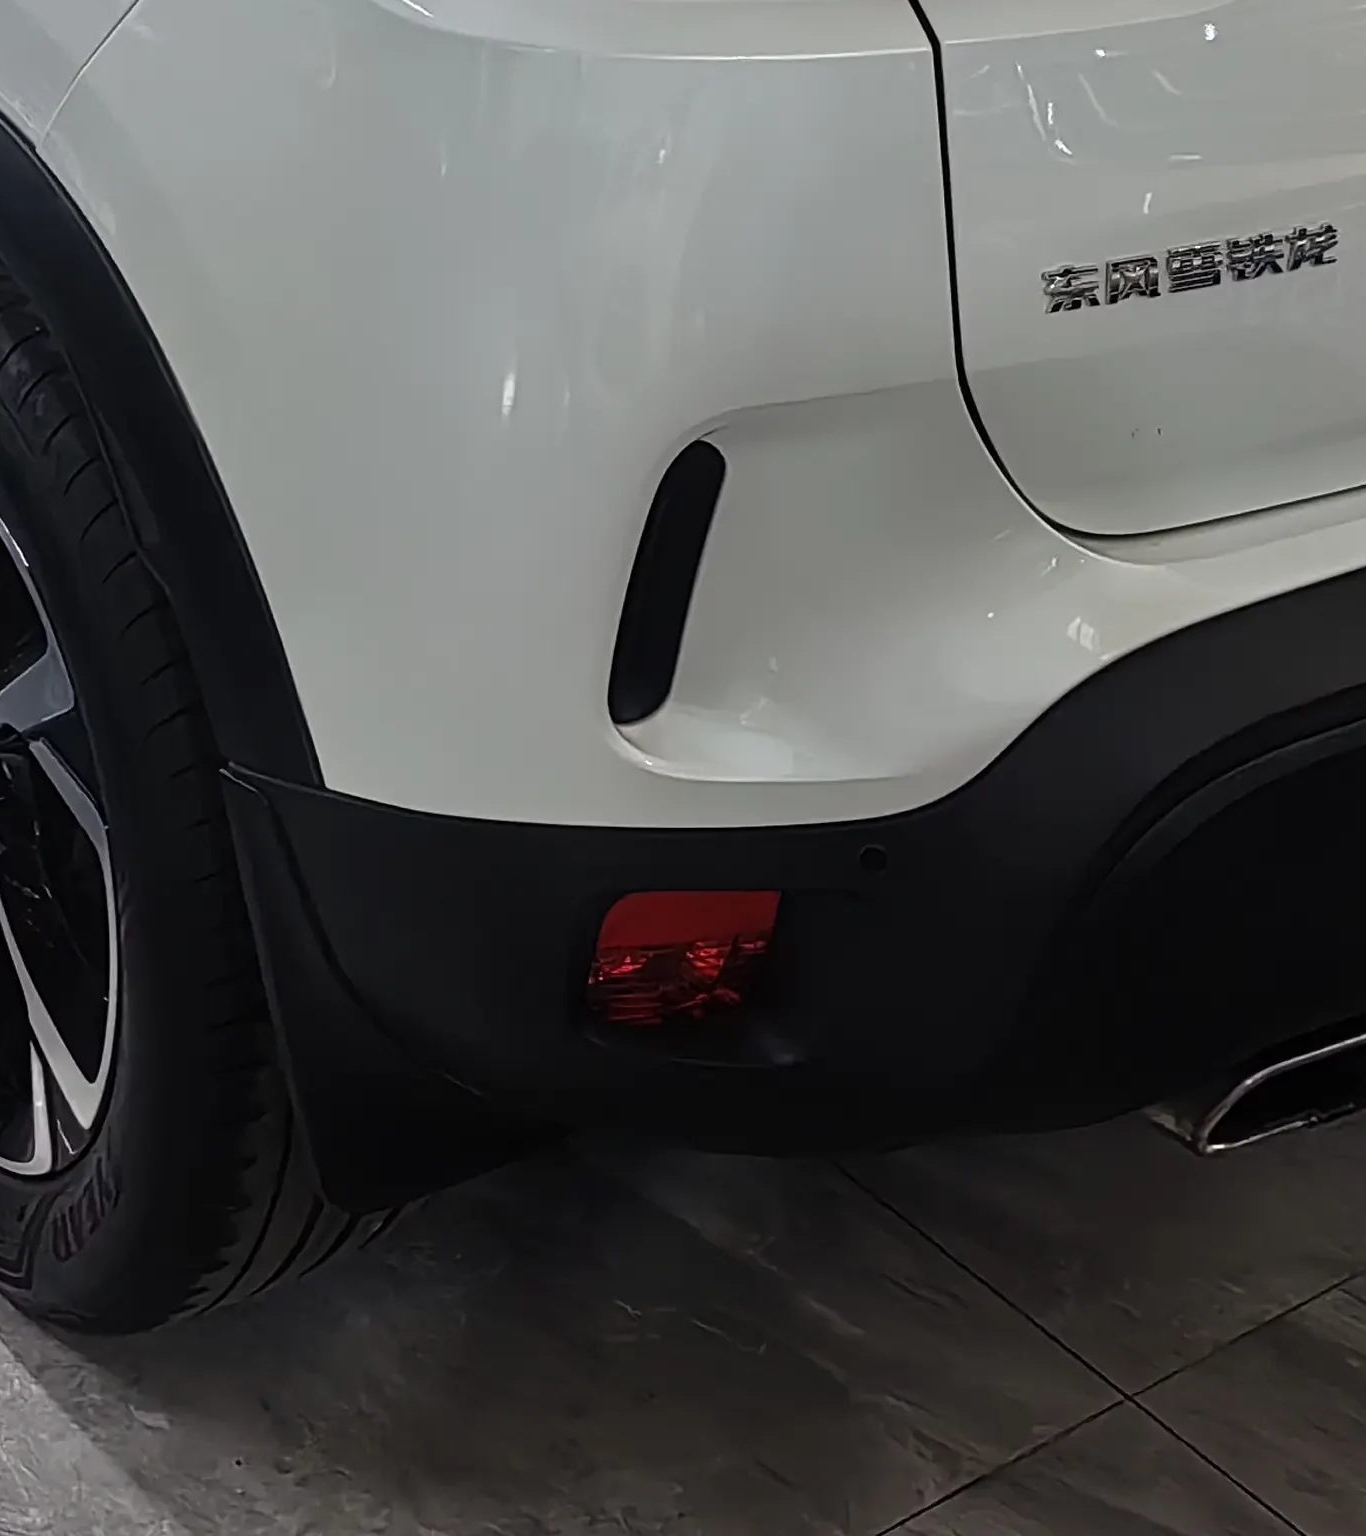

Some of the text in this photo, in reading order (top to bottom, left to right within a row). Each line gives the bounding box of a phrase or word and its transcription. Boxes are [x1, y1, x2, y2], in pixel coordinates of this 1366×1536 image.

[1040, 220, 1340, 314] 东风雪铁龙
